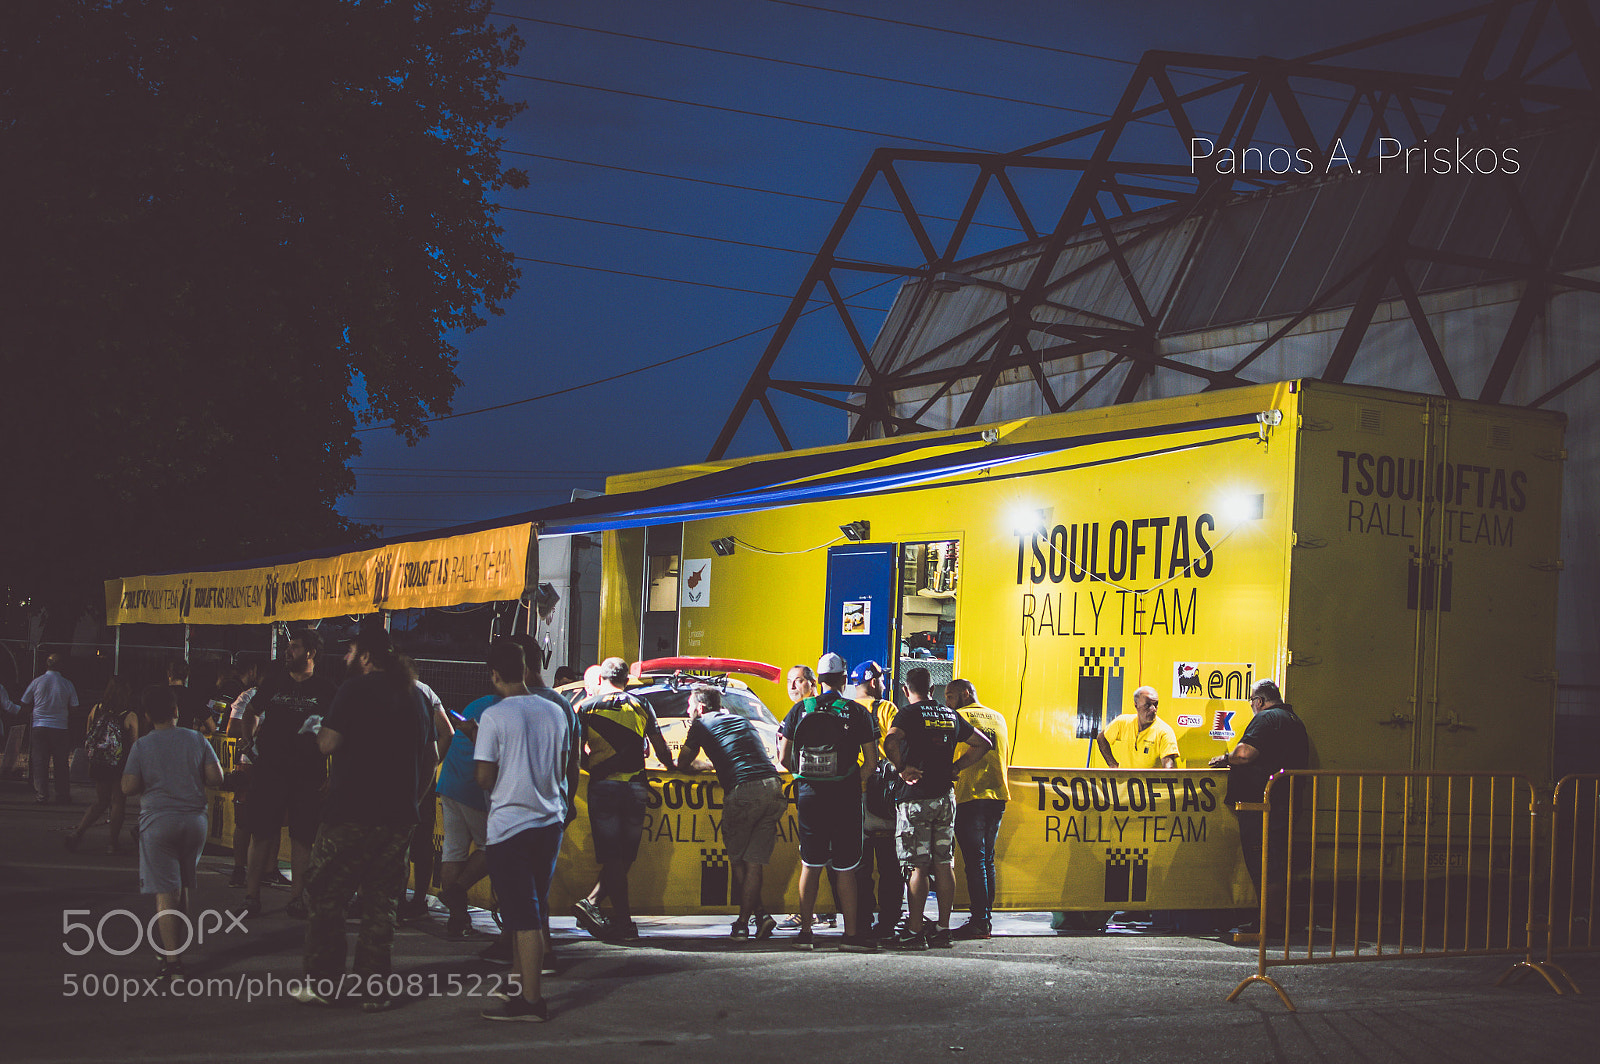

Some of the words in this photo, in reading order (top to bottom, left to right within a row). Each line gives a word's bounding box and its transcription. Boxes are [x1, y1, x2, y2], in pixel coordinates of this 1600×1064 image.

[1337, 450, 1528, 513] TSOULOFTAS
[1348, 500, 1435, 538] RALLY
[1445, 509, 1514, 547] TEAM
[1013, 513, 1215, 585] TSOULOFTAS
[1021, 591, 1107, 636] RALLY
[1116, 588, 1197, 636] TEAM
[1207, 663, 1252, 700] eni
[1031, 776, 1217, 812] TSOULOFTAS
[642, 813, 724, 843] RALLY
[1045, 815, 1130, 843] RALLY
[1138, 815, 1208, 843] TEAM
